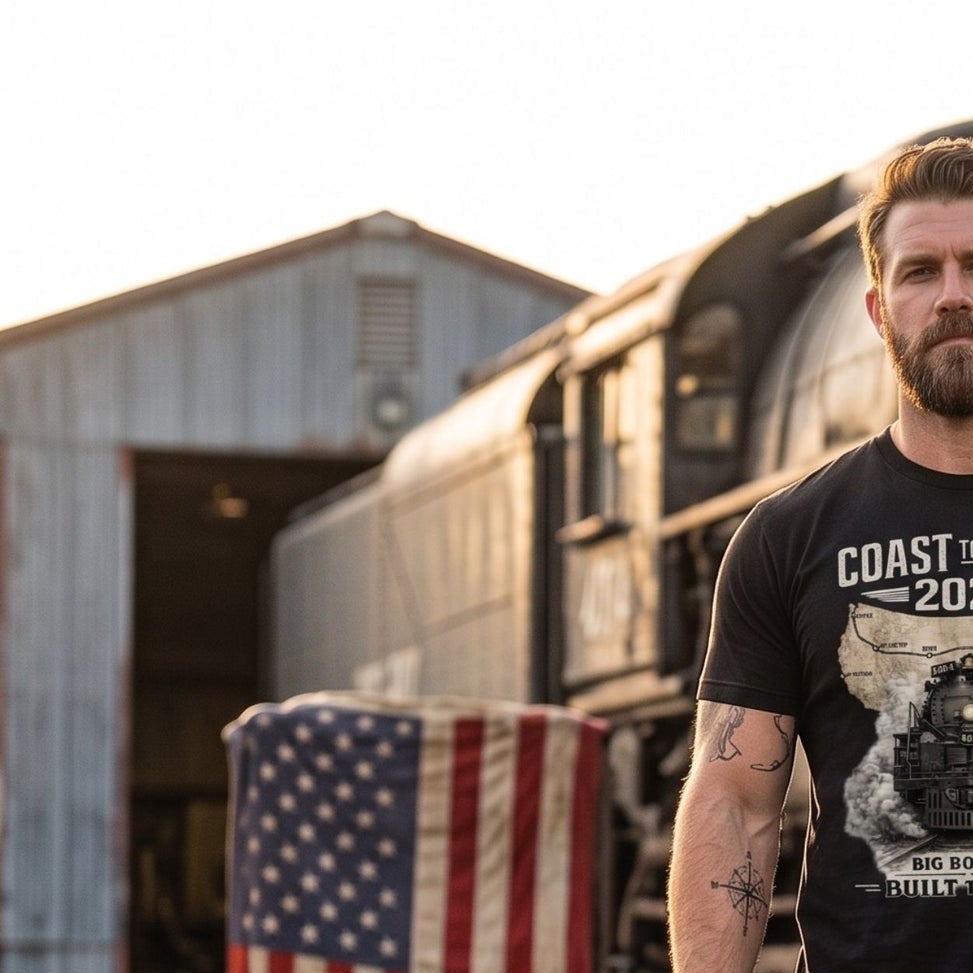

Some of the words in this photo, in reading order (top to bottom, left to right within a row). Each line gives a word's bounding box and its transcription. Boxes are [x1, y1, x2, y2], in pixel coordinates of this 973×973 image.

[838, 533, 953, 588] COAST
[912, 857, 943, 871] BIG
[885, 878, 958, 898] BUILT
